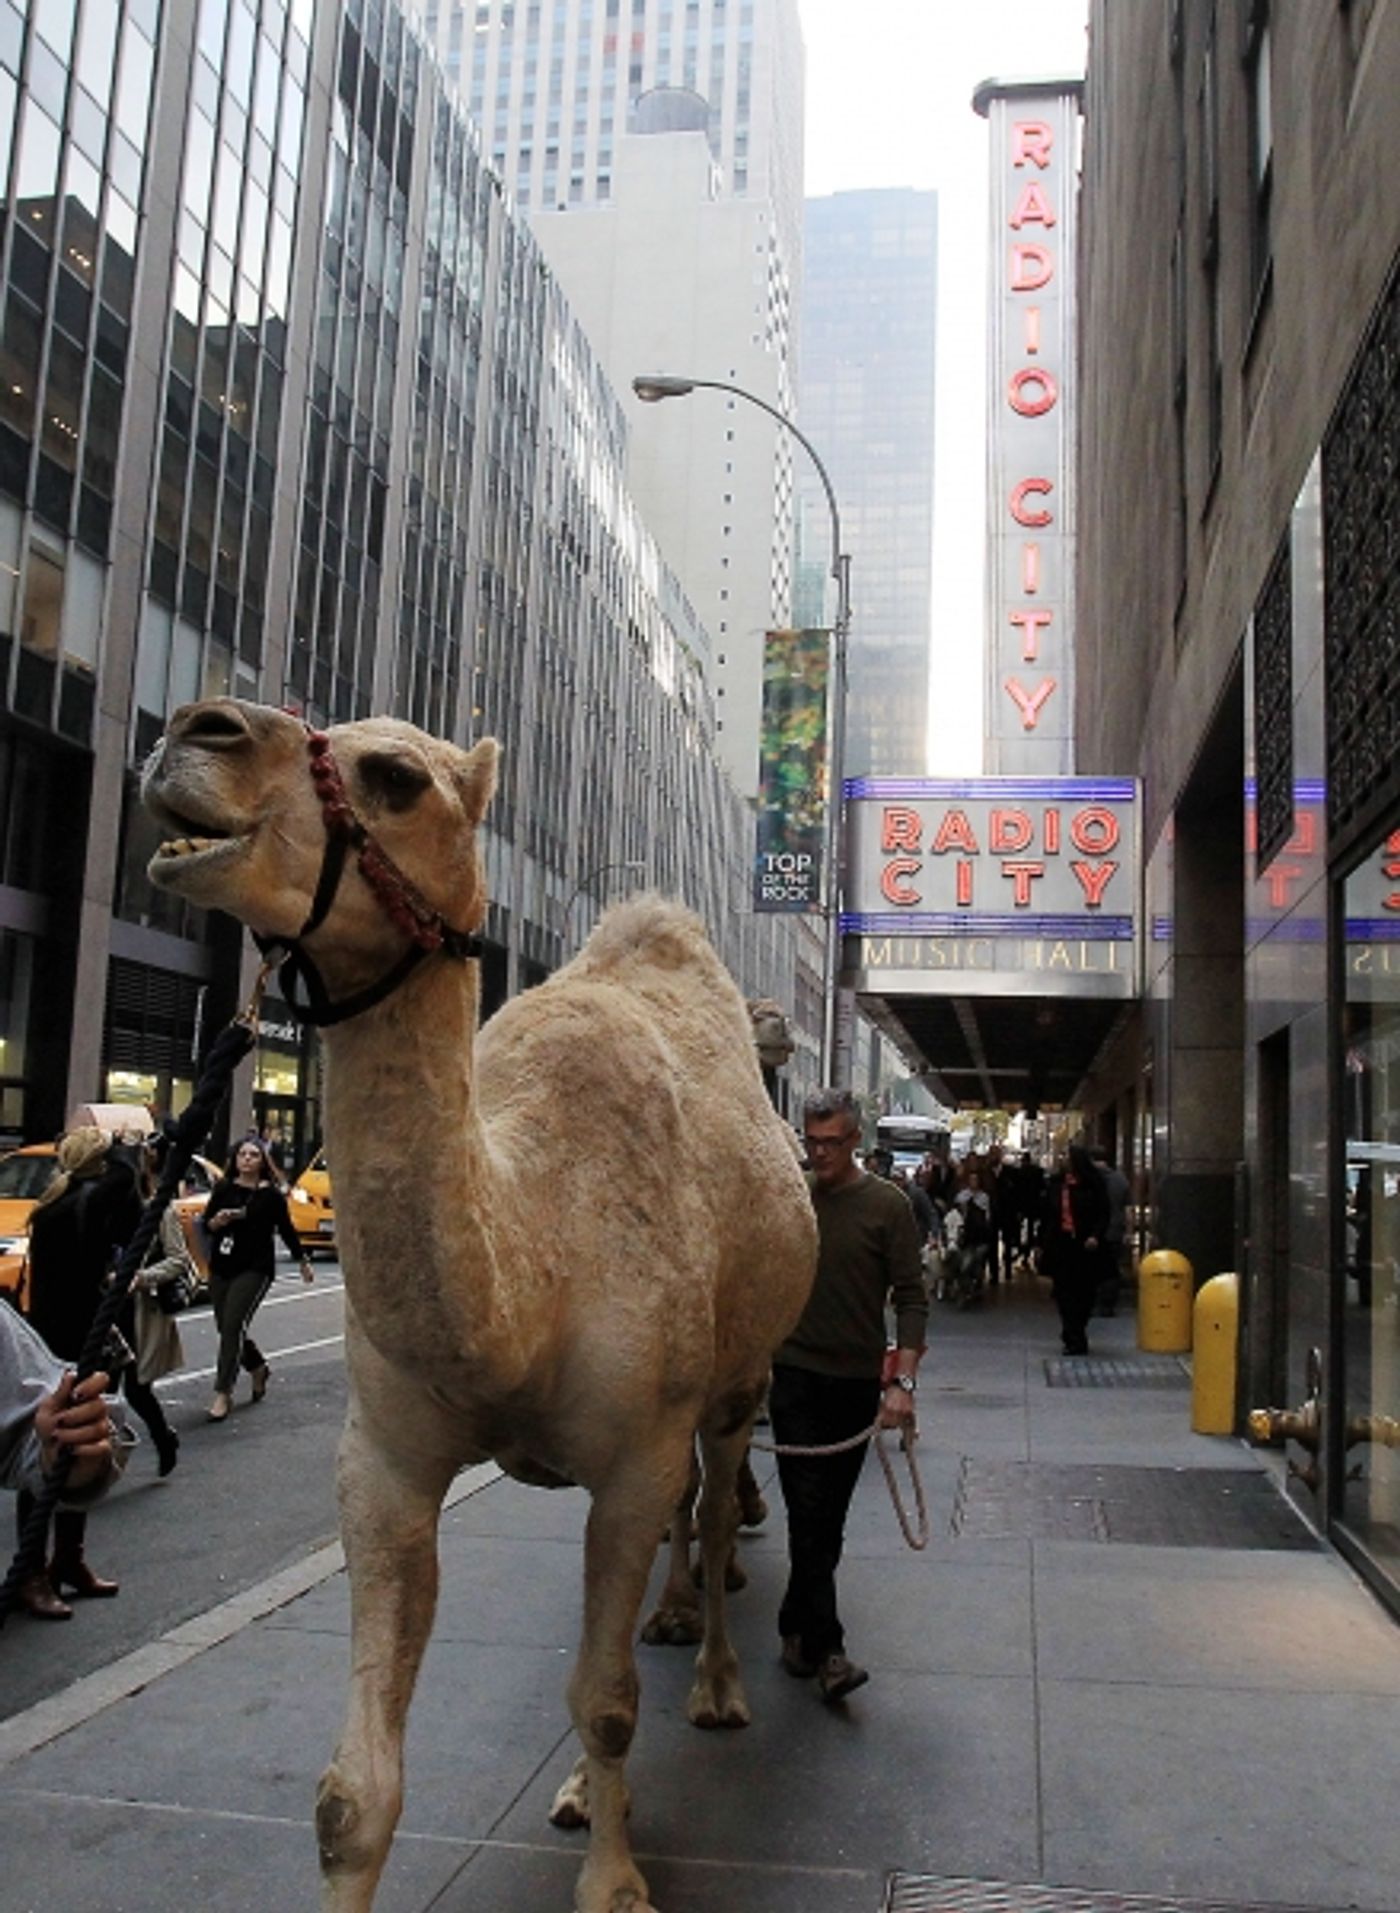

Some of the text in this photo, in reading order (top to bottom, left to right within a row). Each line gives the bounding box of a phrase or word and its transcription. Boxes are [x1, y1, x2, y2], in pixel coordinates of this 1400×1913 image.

[1005, 120, 1057, 732] RADIO CITY
[881, 806, 1121, 856] RADIO
[763, 853, 812, 872] TOP
[881, 857, 1119, 907] CITY
[762, 886, 809, 901] ROCK
[862, 937, 1126, 971] MUSIC HALL
